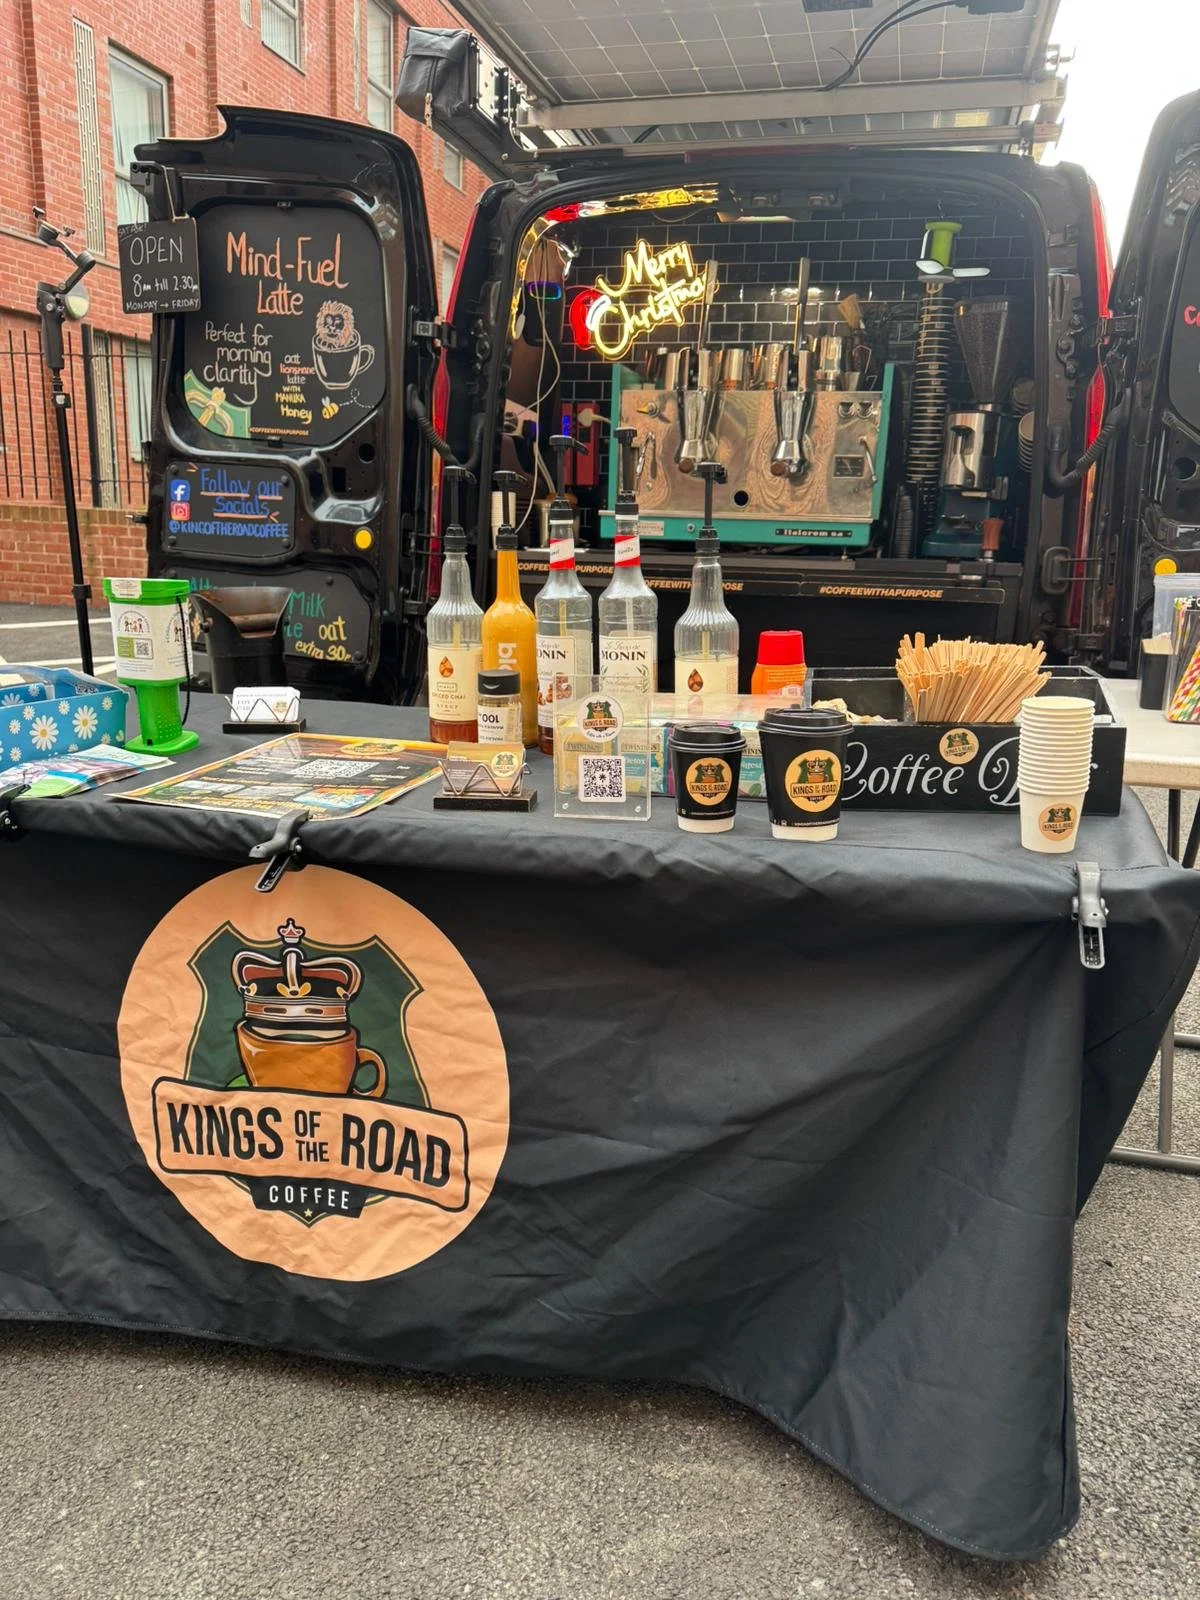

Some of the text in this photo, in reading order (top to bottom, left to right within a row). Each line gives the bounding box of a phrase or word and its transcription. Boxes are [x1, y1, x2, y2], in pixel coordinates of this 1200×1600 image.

[130, 236, 183, 265] OPEN
[226, 231, 349, 289] Mind-Fuel
[598, 240, 694, 298] Merry
[126, 298, 199, 311] MONDAY FRIDAY
[257, 280, 304, 315] Latte
[205, 320, 273, 346] Perfect for
[217, 346, 272, 377] morning
[284, 353, 301, 364] oat
[275, 392, 306, 404] MANUKA
[280, 404, 312, 425] Honey
[199, 468, 283, 497] Follow our
[212, 496, 270, 515] Socials
[819, 585, 944, 599] #COFFEEWITHAPURPOSE
[318, 615, 348, 641] oat
[294, 639, 325, 660] extra
[842, 741, 965, 801] Coffee
[792, 784, 814, 795] KINGS
[166, 1102, 451, 1188] KINGS OF ROAD
[295, 1139, 330, 1163] THE
[268, 1184, 350, 1210] COFFEE
